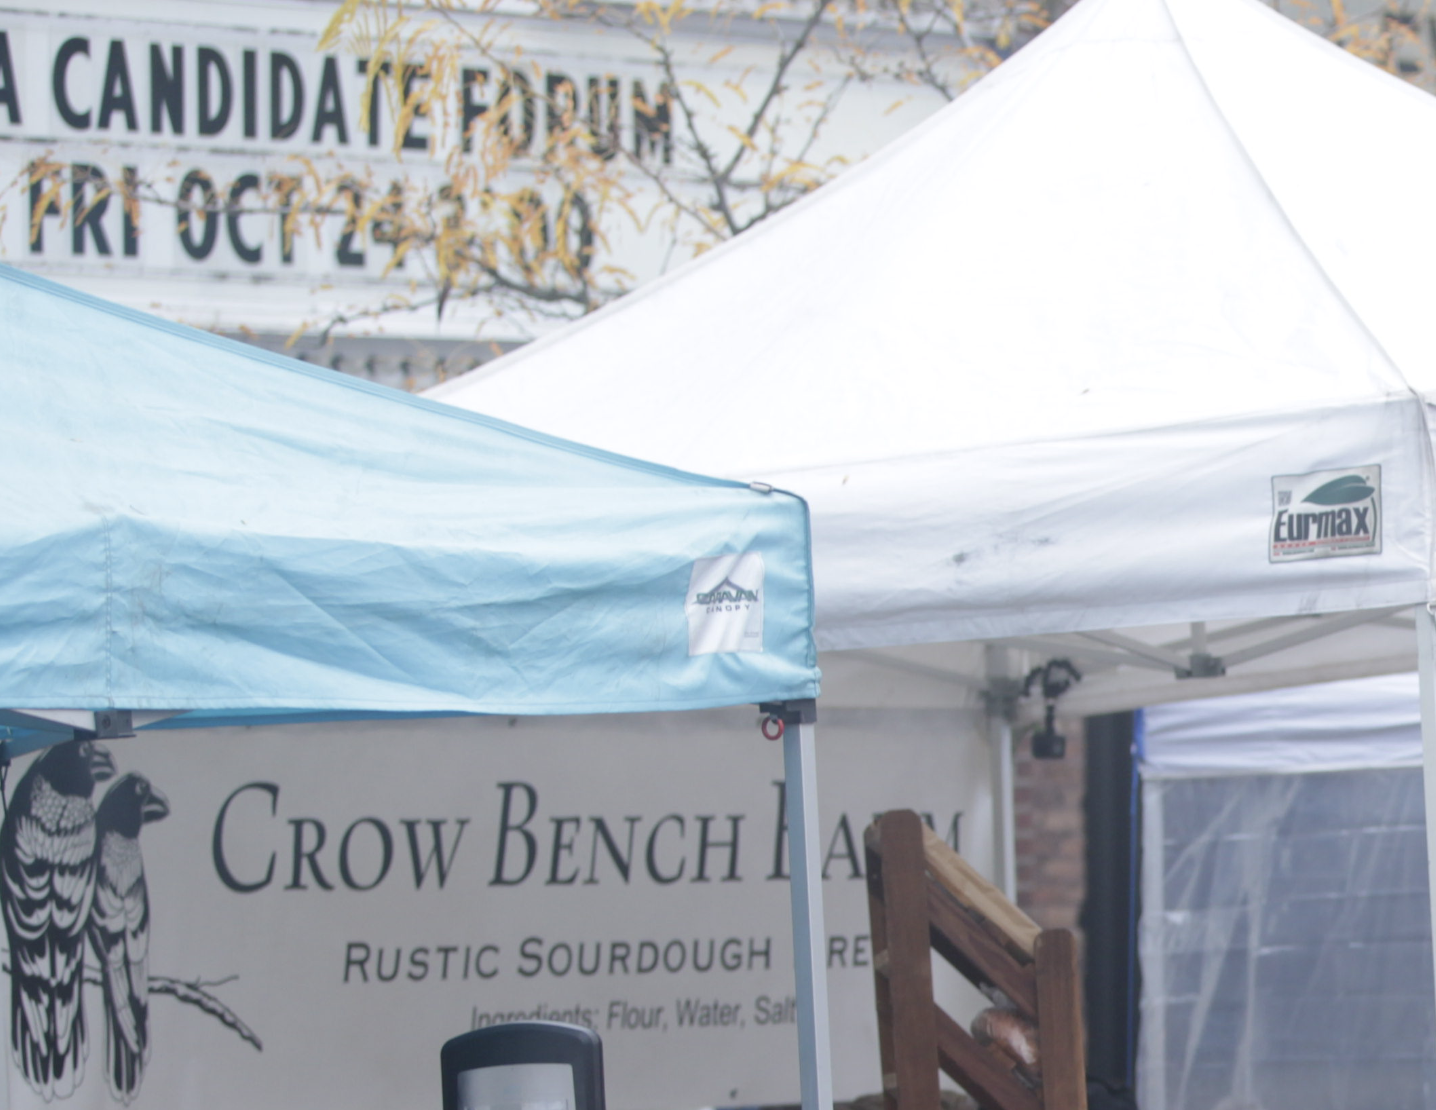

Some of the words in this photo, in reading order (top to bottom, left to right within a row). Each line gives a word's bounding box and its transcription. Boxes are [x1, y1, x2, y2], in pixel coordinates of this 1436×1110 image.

[53, 37, 431, 150] CANDIDATE
[462, 67, 673, 164] FORUM
[29, 162, 139, 257] FRI
[177, 168, 304, 265] OCT
[336, 180, 405, 268] 24
[1274, 506, 1369, 543] Eurmax
[212, 781, 471, 894] CROW
[487, 780, 746, 886] BENCH
[343, 941, 500, 983] RUSTIC
[517, 936, 772, 978] SOURDOUGH
[606, 1000, 668, 1033] Flour,
[675, 996, 746, 1028] Water,
